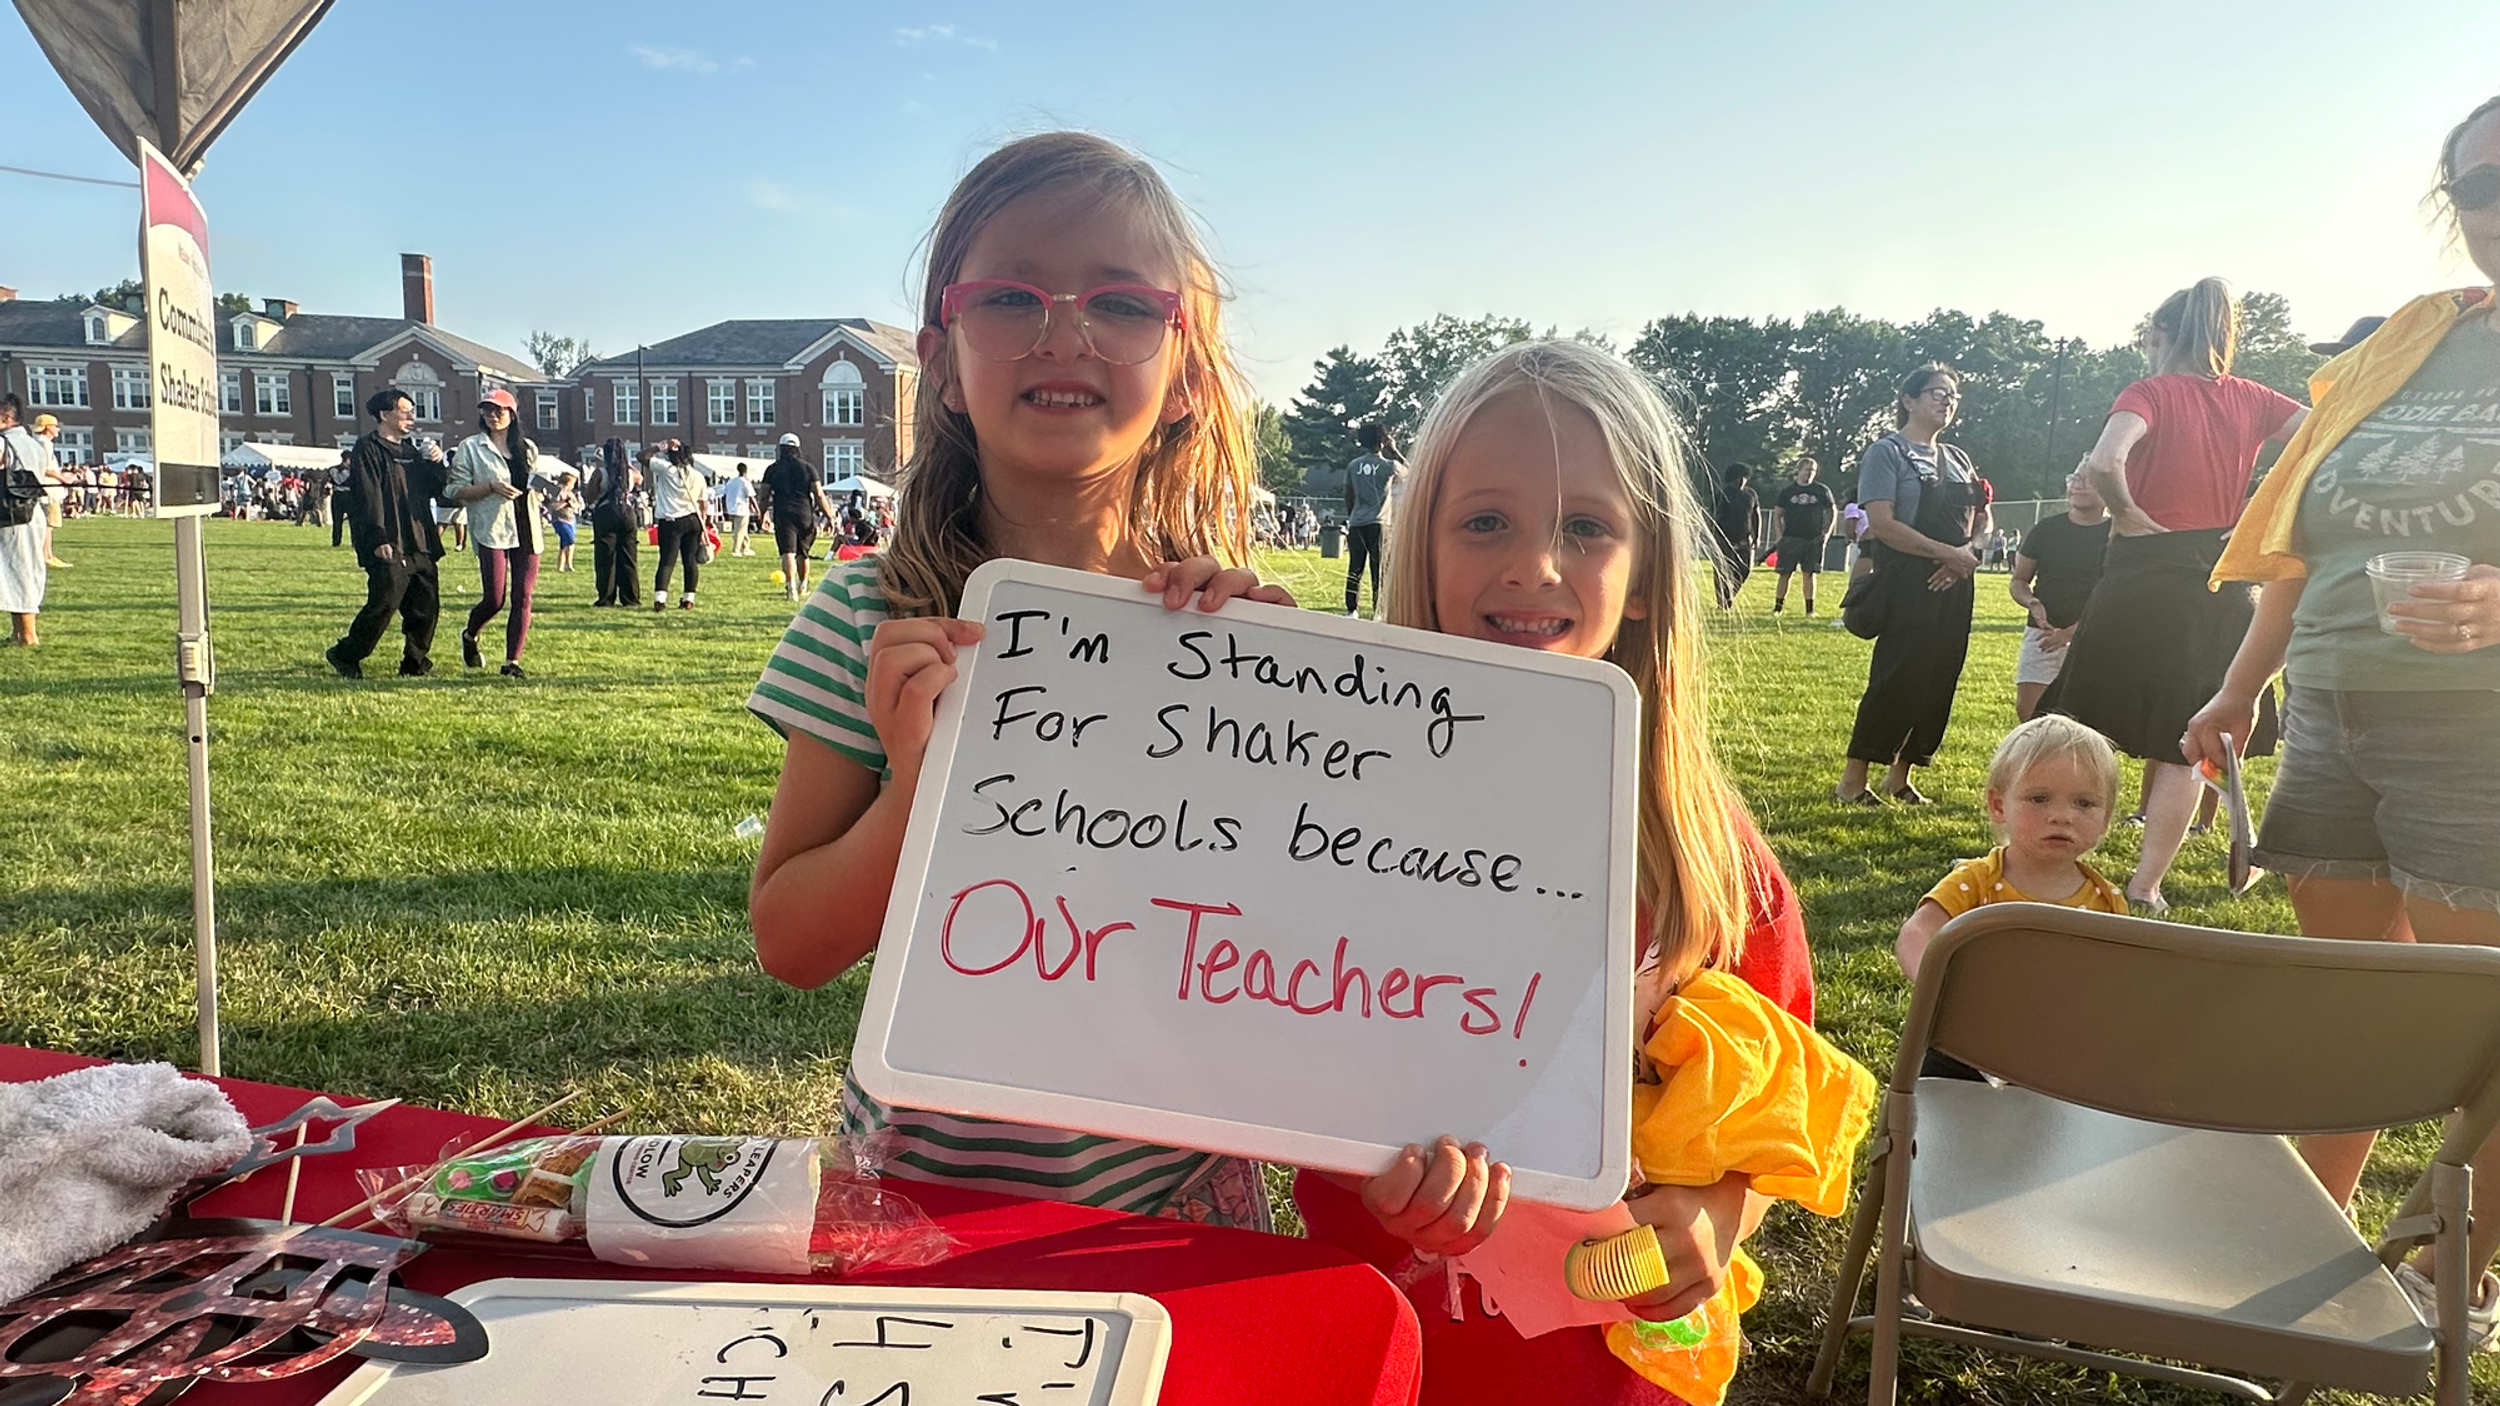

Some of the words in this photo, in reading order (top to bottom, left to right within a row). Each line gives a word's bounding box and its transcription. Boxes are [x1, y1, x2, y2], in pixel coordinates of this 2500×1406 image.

[160, 361, 200, 413] Shaker
[2378, 404, 2457, 421] ODIE
[2450, 403, 2500, 422] BA
[2313, 452, 2500, 537] DVENTUR
[994, 610, 1110, 665] I'm
[1166, 630, 1486, 760] Standing
[991, 686, 1109, 742] For
[1146, 703, 1392, 781] Shaker
[961, 774, 1243, 852] Schools
[1288, 802, 1585, 901] because...
[941, 878, 1136, 983] Our
[1150, 897, 1543, 1069] Teachers!
[447, 1201, 525, 1221] SMARTIES
